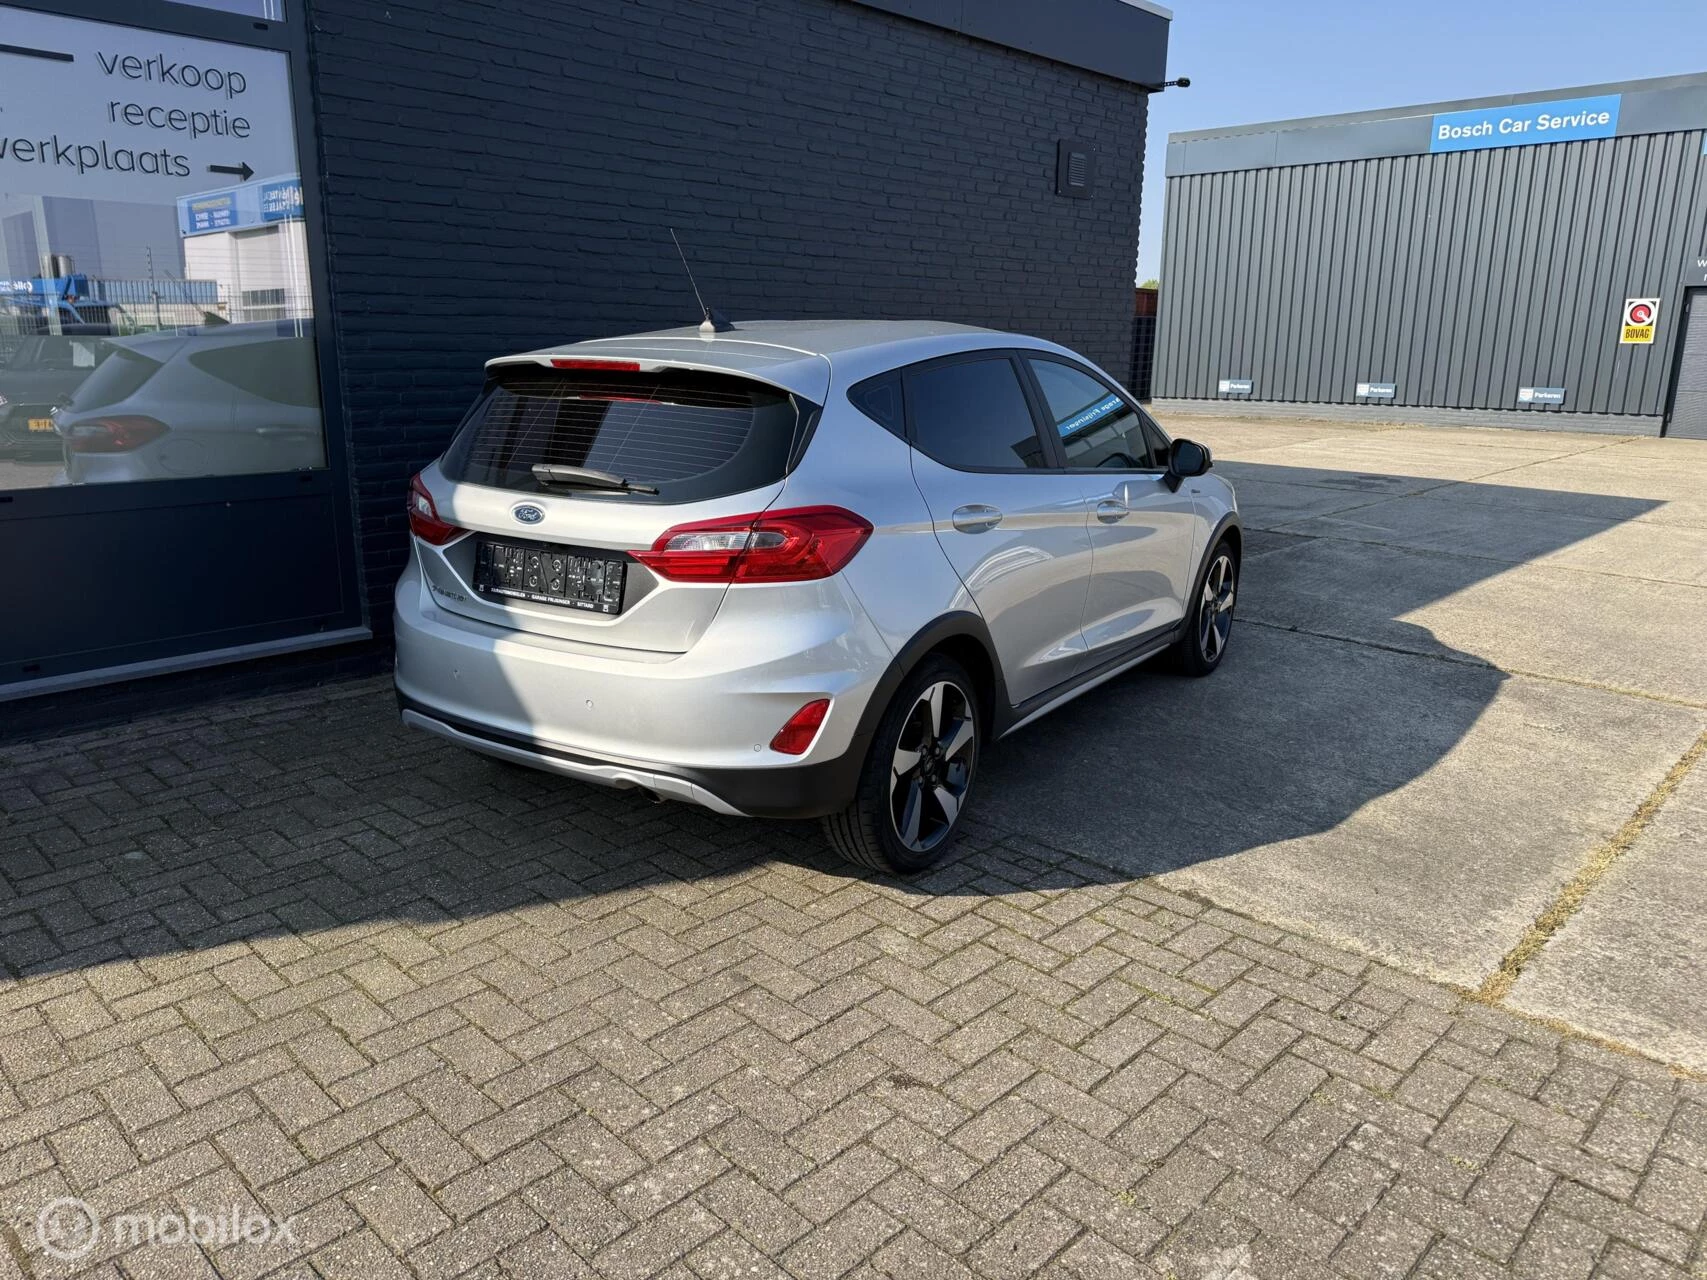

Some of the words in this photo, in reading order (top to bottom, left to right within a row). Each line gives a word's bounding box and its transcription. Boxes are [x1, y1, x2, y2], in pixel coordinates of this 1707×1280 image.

[98, 51, 247, 99] verkoop
[110, 101, 251, 139] receptie
[1438, 121, 1493, 141] Bosch
[1498, 117, 1532, 135] Car
[1536, 111, 1611, 131] Service
[1625, 328, 1650, 339] BOVAG
[517, 507, 539, 521] Ford
